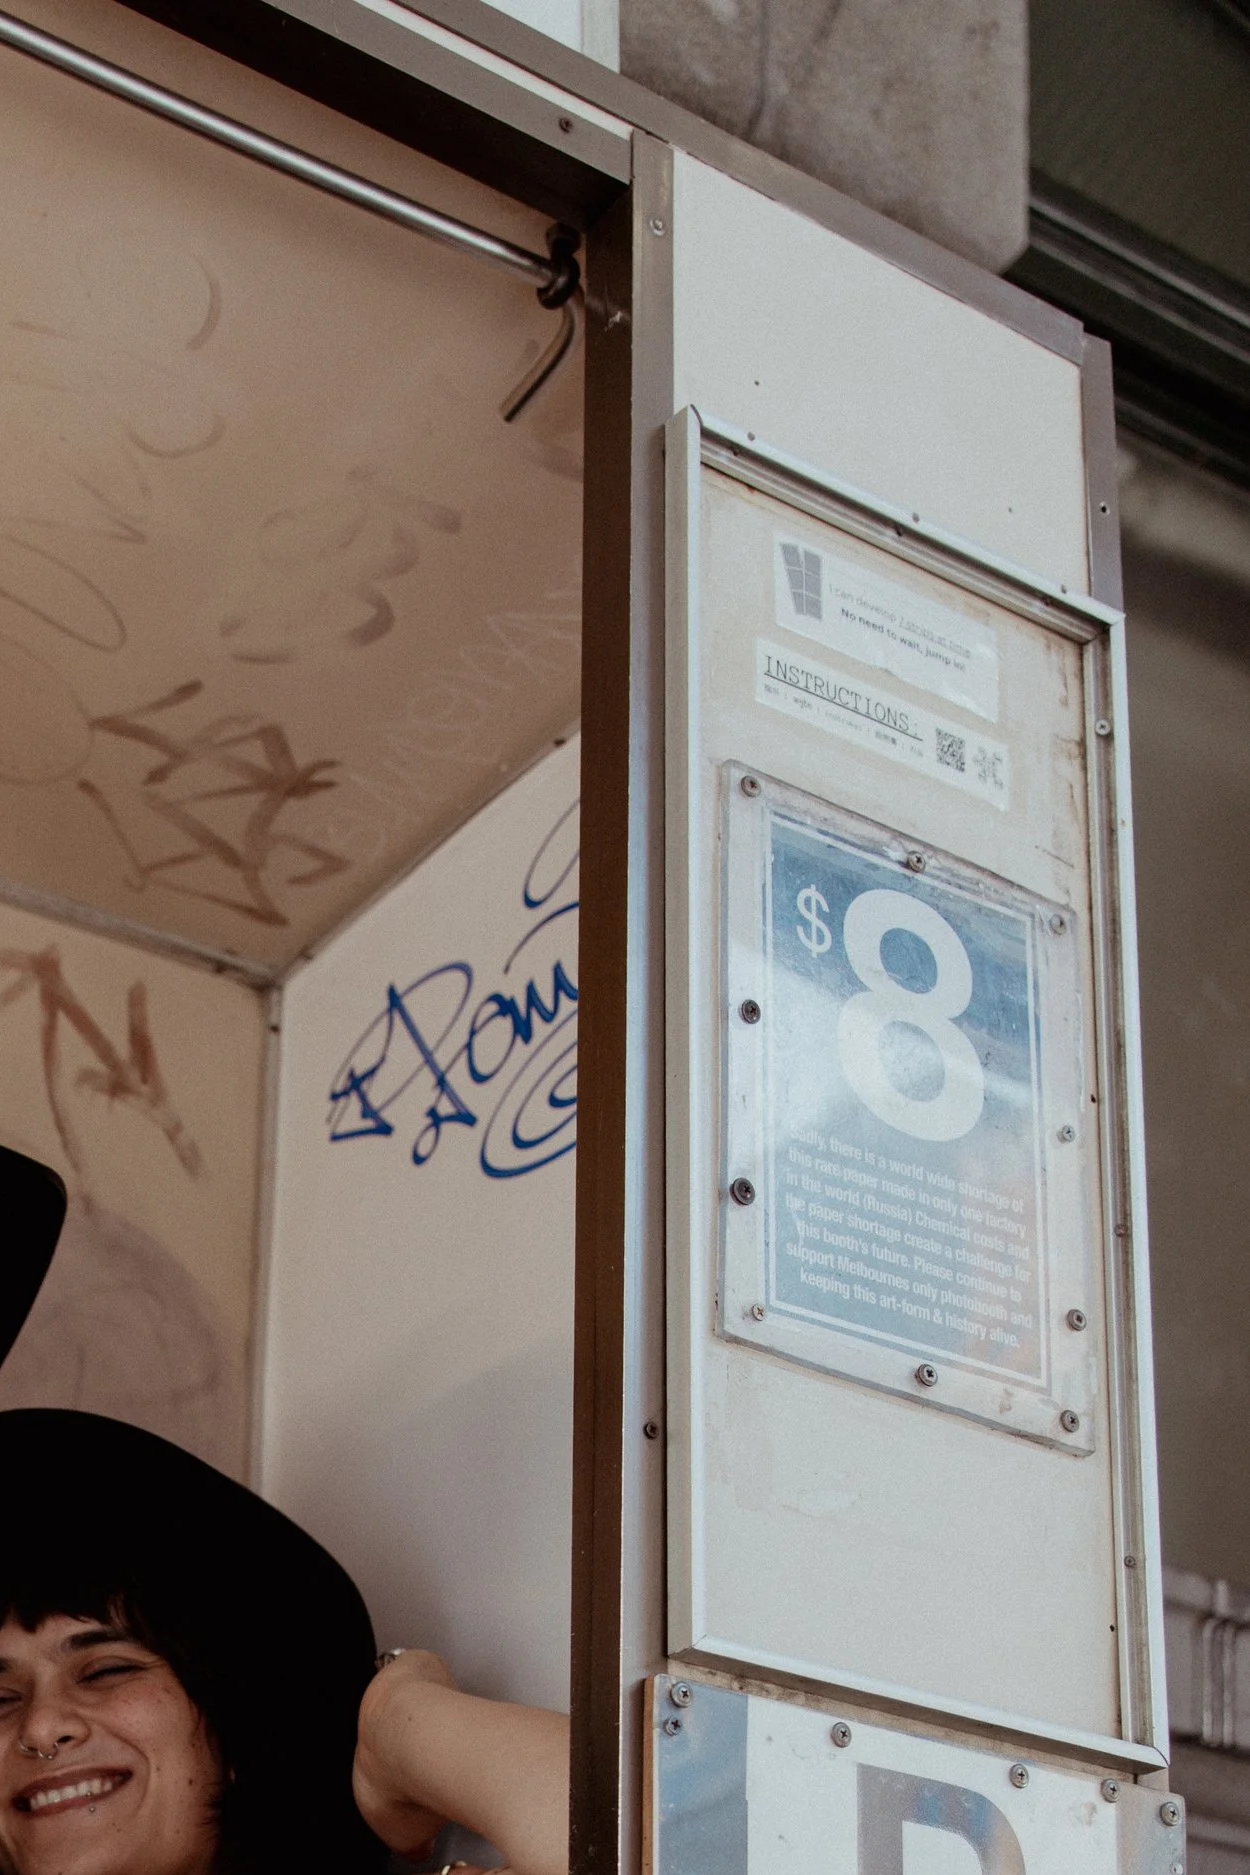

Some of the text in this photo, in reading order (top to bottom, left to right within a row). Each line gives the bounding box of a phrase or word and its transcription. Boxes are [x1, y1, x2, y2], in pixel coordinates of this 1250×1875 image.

[841, 608, 856, 621] No
[859, 616, 884, 634] need
[886, 628, 897, 640] to
[924, 645, 951, 666] jump
[786, 1169, 1030, 1260] in the world (Russia) Chemical costs and
[789, 1145, 1027, 1240] this rare paper made in only one factory
[830, 1137, 861, 1161] there
[864, 1149, 876, 1165] is
[878, 1155, 886, 1169] a
[889, 1158, 923, 1181] world
[927, 1170, 955, 1191] wide
[958, 1182, 1010, 1209] shortage
[1012, 1199, 1025, 1214] of
[785, 1191, 1032, 1284] the paper shortage create a challenge for
[797, 1219, 1022, 1303] this booth's future. Please continue to
[785, 1241, 1033, 1330] support Melbournes only photobooth and
[800, 1267, 1020, 1349] keeping this art-form & history alive.
